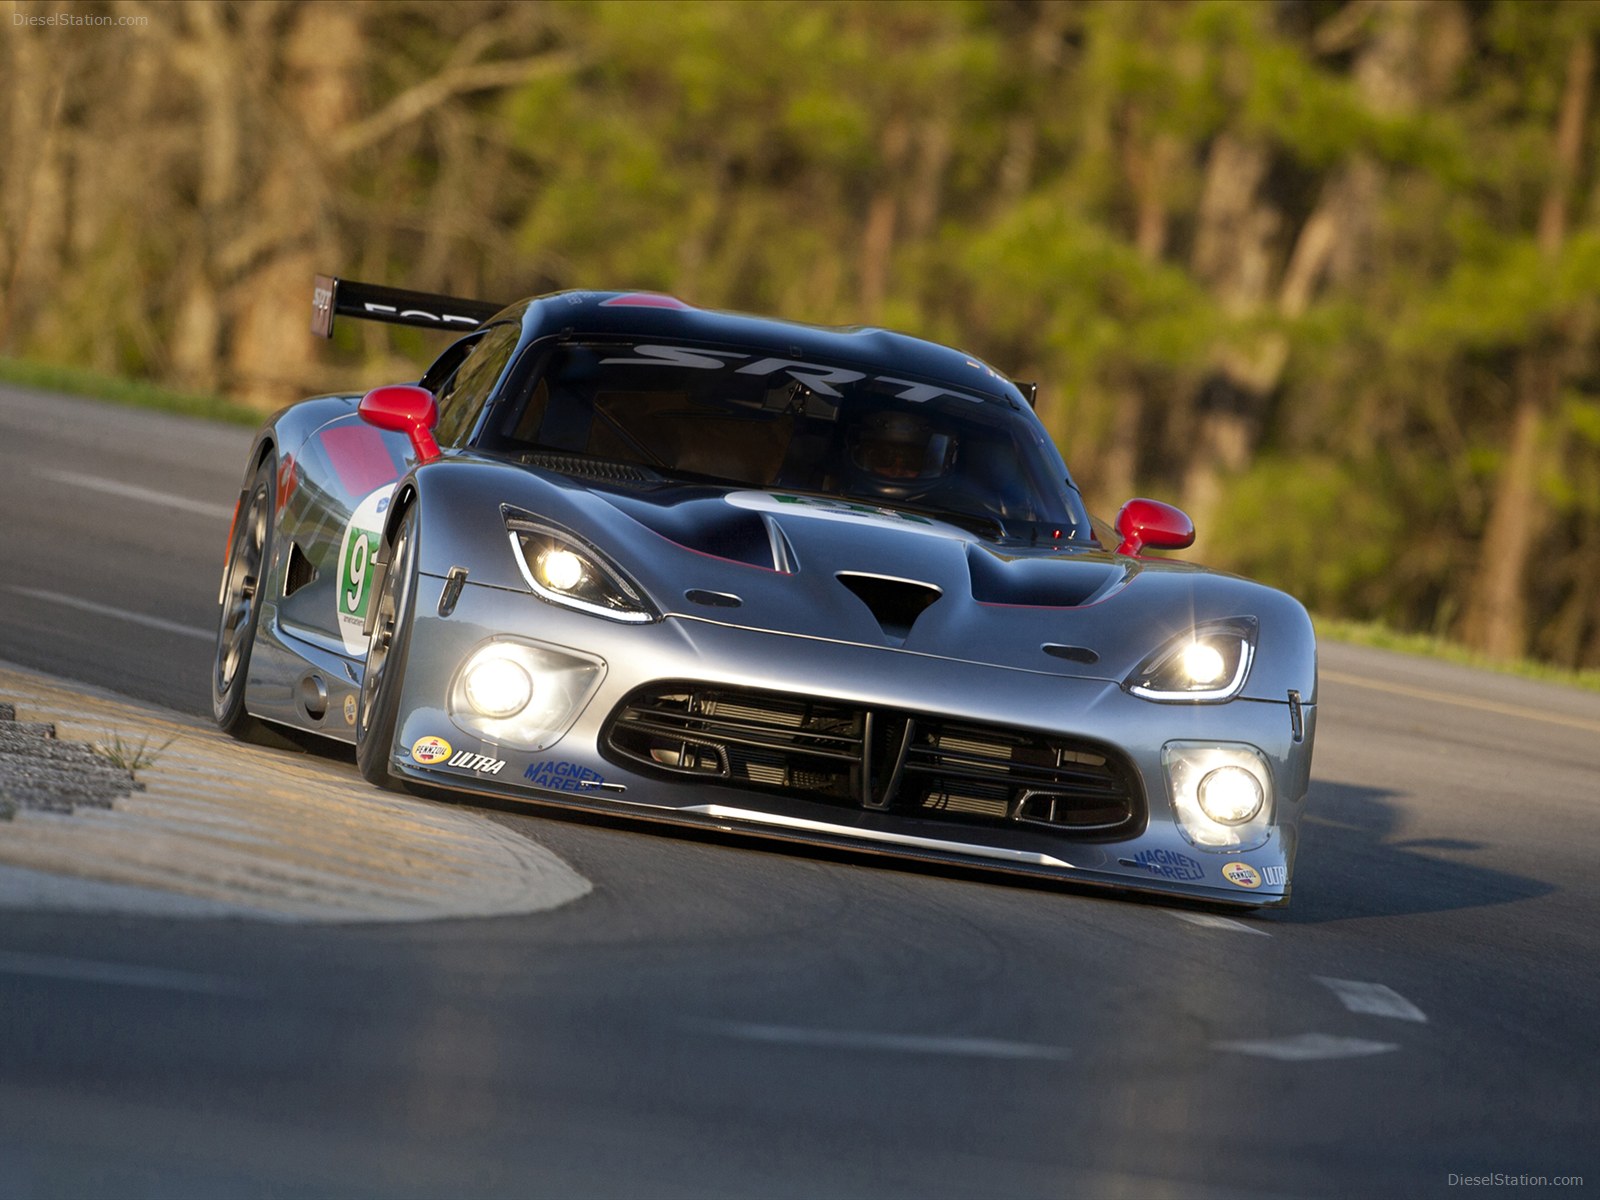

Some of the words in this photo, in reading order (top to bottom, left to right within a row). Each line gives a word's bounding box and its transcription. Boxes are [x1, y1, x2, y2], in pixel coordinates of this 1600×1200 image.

[598, 344, 985, 403] SRT
[347, 533, 380, 613] 9
[415, 746, 447, 756] PENNZOIL
[447, 750, 507, 775] ULTRA
[524, 761, 605, 786] MAGNETI
[1134, 848, 1204, 872] MAGNETI
[1228, 870, 1257, 880] PENNZOIL
